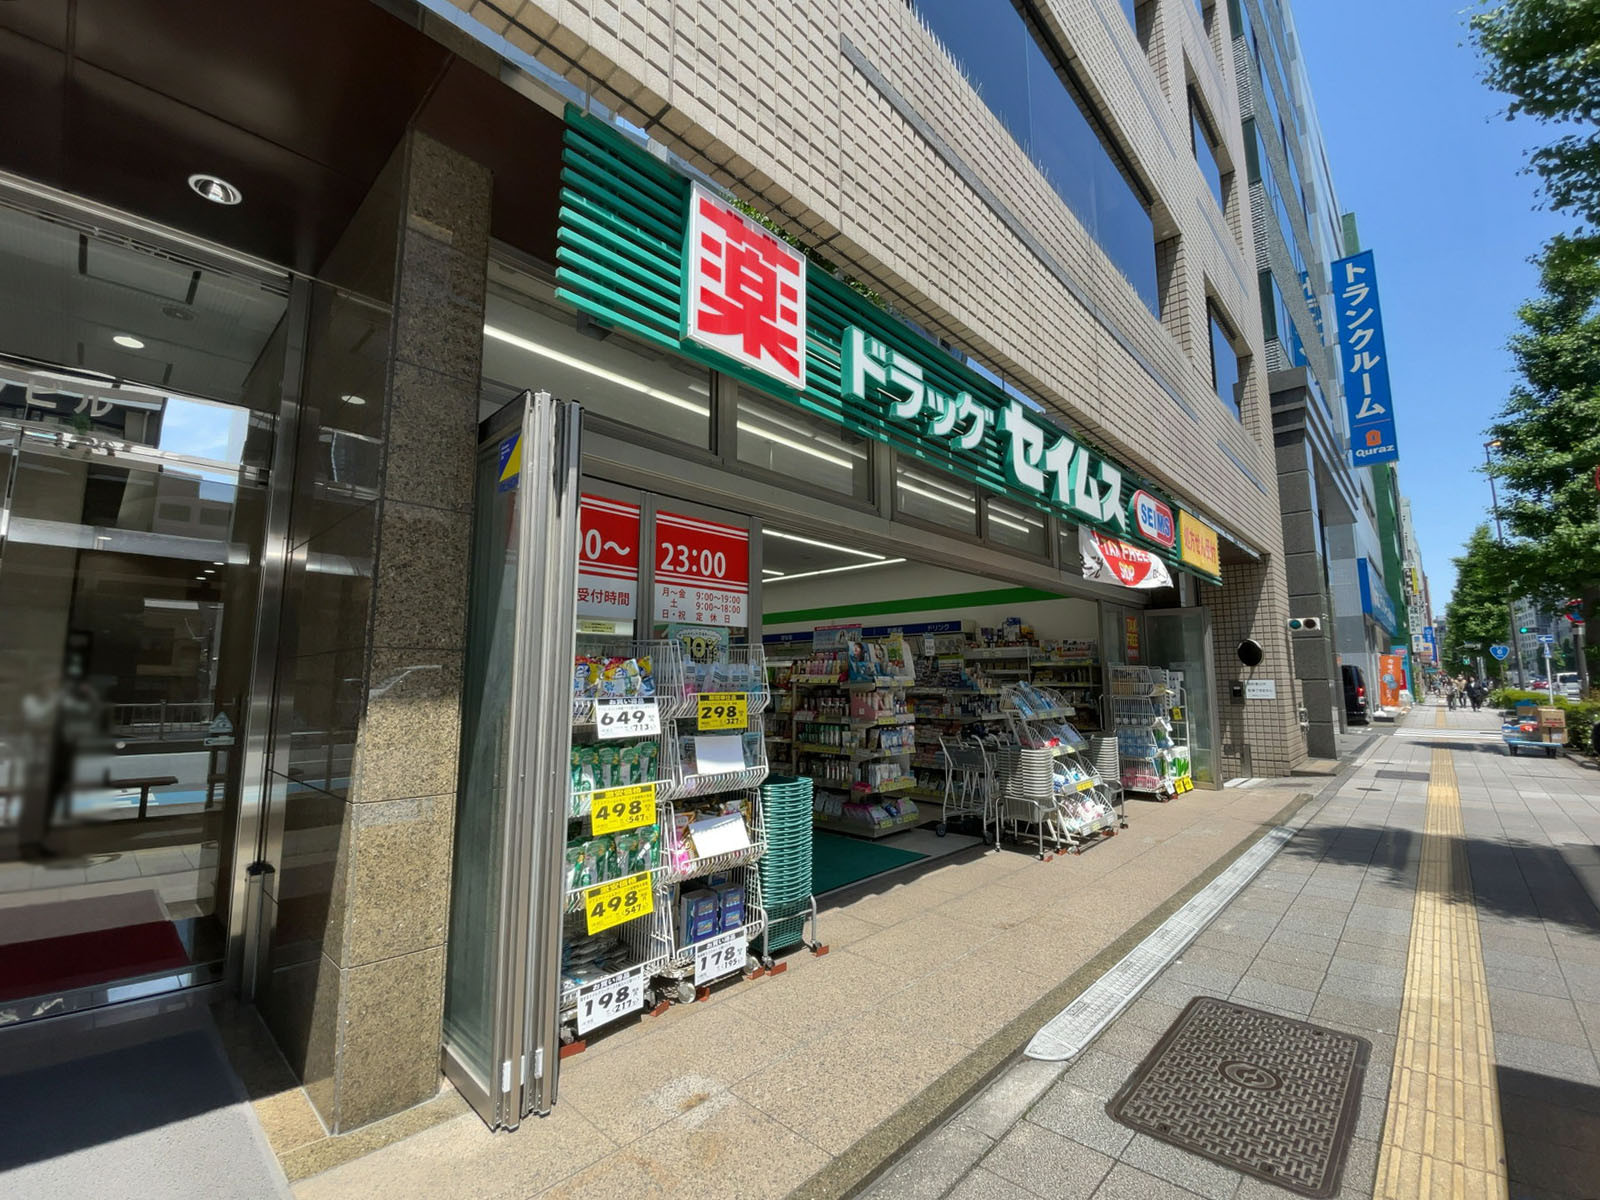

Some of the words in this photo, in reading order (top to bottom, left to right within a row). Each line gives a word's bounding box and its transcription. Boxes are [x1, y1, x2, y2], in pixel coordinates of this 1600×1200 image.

[698, 197, 800, 379] 薬
[1342, 262, 1387, 419] トランクルーム
[0, 380, 113, 417] ビル
[846, 325, 994, 450] ドラッグ
[1001, 400, 1126, 532] セイムス
[1355, 445, 1394, 458] Quraz
[1141, 503, 1170, 537] SEIMS
[660, 542, 726, 578] 23:00
[577, 587, 630, 607] 受付時間
[669, 598, 678, 608] 土
[601, 710, 645, 726] 649
[701, 706, 737, 719] 298
[596, 800, 642, 820] 498
[591, 890, 638, 918] 498
[700, 946, 735, 971] 178
[585, 986, 629, 1017] 198
